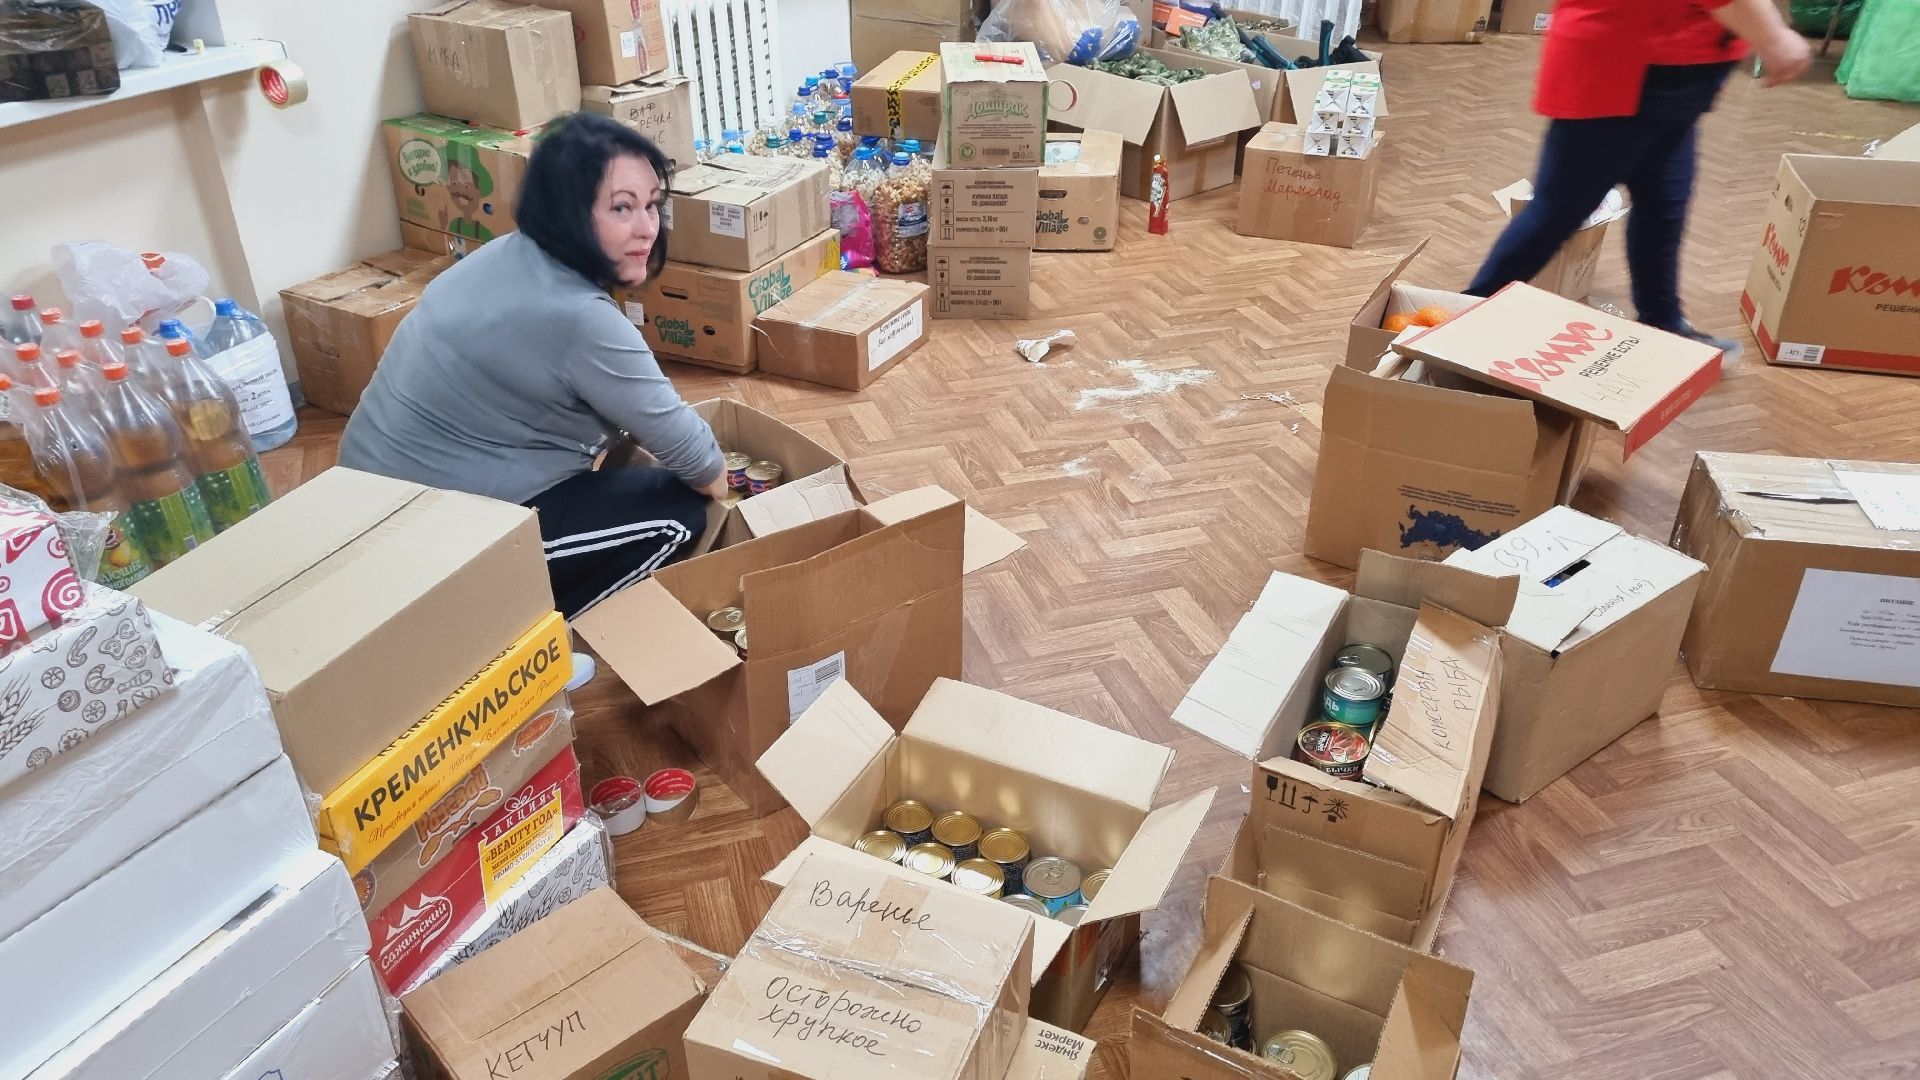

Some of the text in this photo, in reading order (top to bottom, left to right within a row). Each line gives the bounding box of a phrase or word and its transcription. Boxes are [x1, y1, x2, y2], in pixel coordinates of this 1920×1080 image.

[640, 111, 672, 129] РЕЧКА
[748, 261, 784, 299] Global
[654, 314, 690, 330] Global
[1578, 347, 1621, 379] РЕШЕНИЕ
[353, 636, 562, 832] КРЕМЕНКУЛЬСКОЕ
[1325, 764, 1360, 774] БЫЧКИ
[485, 824, 531, 863] «BEAUTY
[808, 879, 936, 932] Варенье
[381, 898, 448, 970] Сажинский
[485, 1010, 586, 1080] КЕТЧУП
[1034, 1039, 1081, 1061] Яндекс
[1037, 1028, 1085, 1051] Маркет
